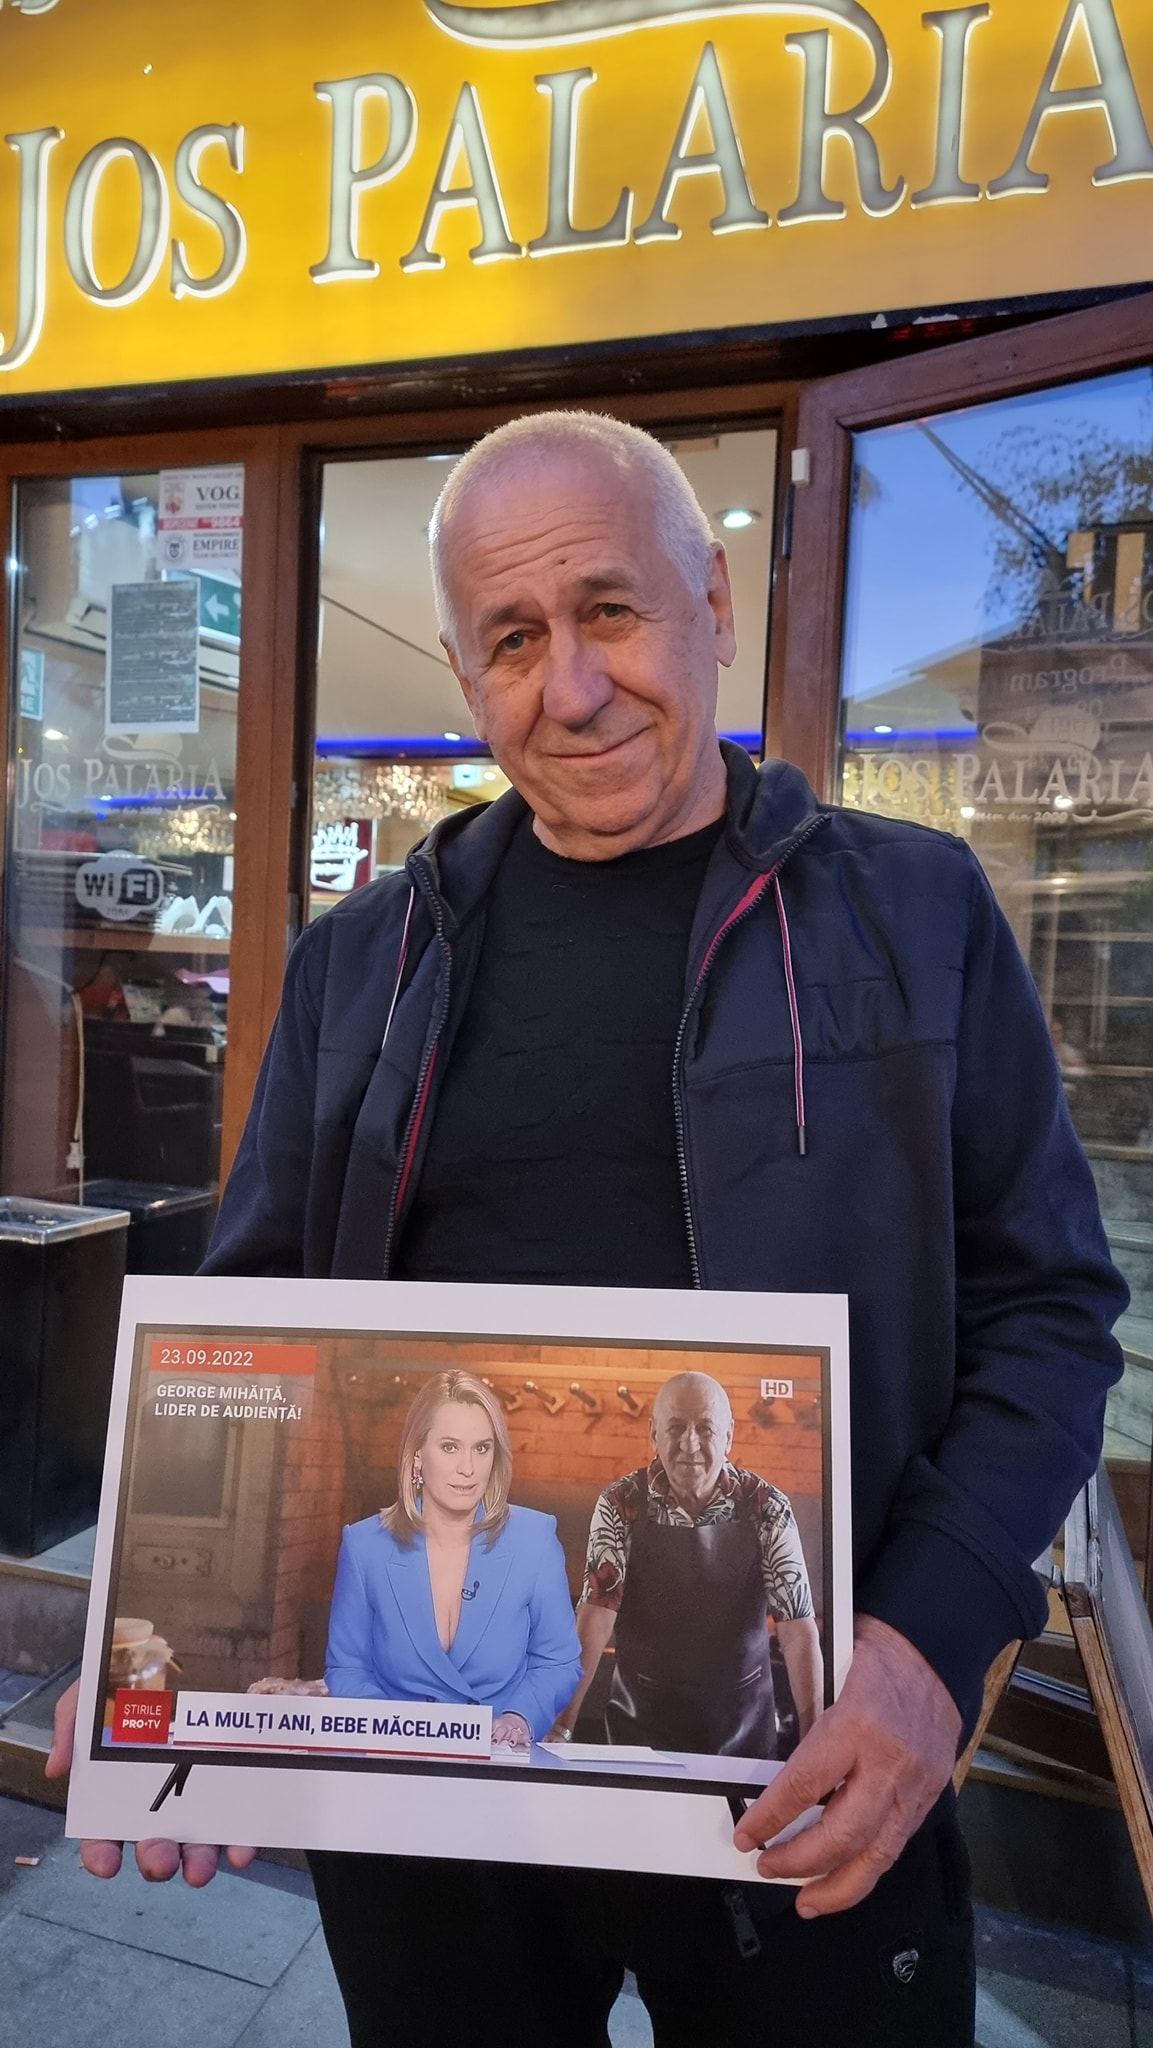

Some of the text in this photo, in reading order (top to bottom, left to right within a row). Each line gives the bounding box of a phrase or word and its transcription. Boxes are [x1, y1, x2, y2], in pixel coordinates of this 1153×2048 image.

[0, 0, 1153, 371] JOS PALARIA
[196, 485, 240, 501] VOG
[193, 539, 239, 551] EMPIRE
[19, 757, 227, 808] JOS PALARIA
[858, 753, 931, 808] JOS
[950, 752, 1153, 804] PALARIA
[1034, 811, 1068, 824] 2000
[160, 1348, 254, 1367] 23.09.2022
[156, 1384, 287, 1404] GEORGE MIHĂIȚĂ,
[765, 1382, 789, 1395] HD
[154, 1402, 302, 1423] LIDER DE AUDIENȚĂ!
[123, 1704, 162, 1717] ȘTIRILE
[186, 1710, 481, 1741] LA MULȚI ANI, BEBE MĂCELARU!
